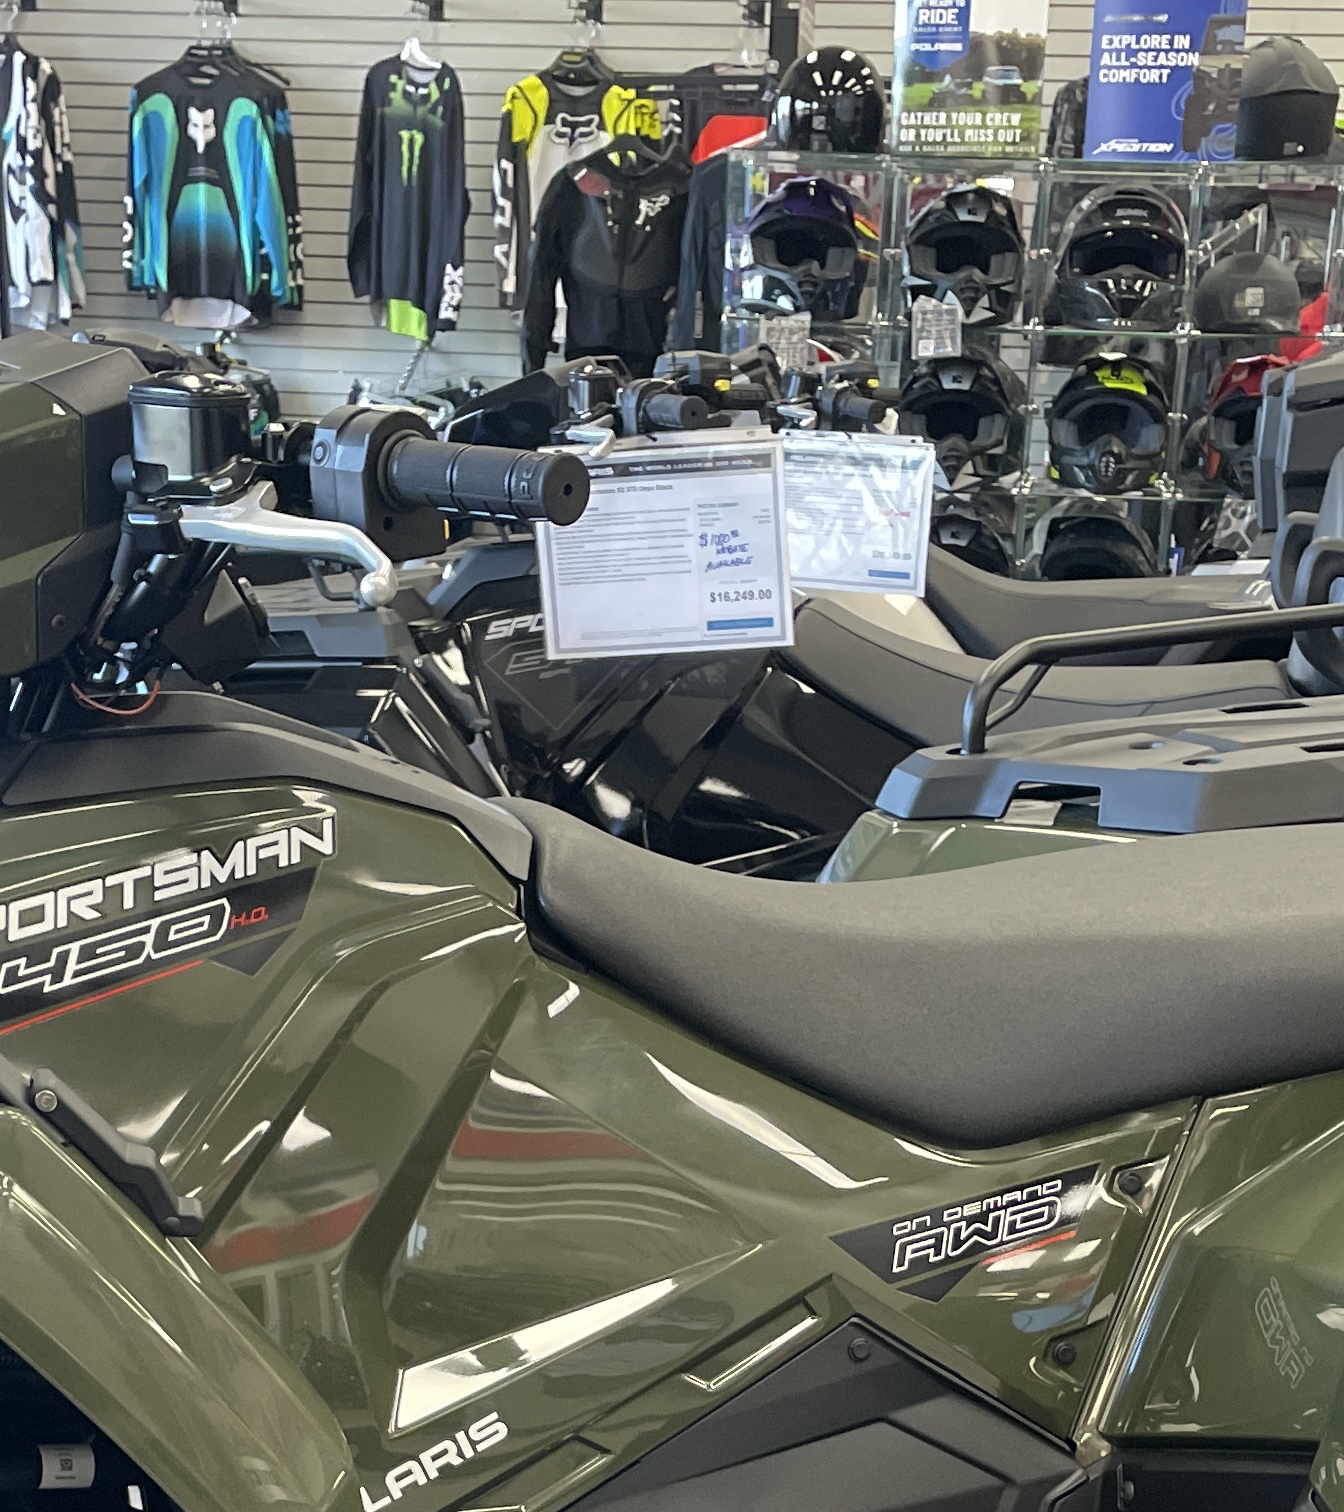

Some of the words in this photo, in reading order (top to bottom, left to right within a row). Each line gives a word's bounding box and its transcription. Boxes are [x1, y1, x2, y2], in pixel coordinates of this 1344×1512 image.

[918, 8, 960, 25] RIDE
[1101, 34, 1171, 50] EXPLORE
[1173, 34, 1191, 50] IN
[1100, 51, 1200, 67] ALL-SEASON
[1098, 68, 1172, 84] COMFORT
[900, 112, 947, 127] GATHER
[951, 112, 983, 126] YOUR
[985, 112, 1022, 126] CREW
[899, 129, 916, 142] OR
[920, 129, 961, 143] YOU'LL
[964, 129, 994, 143] MISS
[997, 129, 1023, 143] OUT
[1092, 142, 1175, 155] XPEDITION
[709, 589, 773, 603] $16,249.00
[229, 905, 270, 930] H.O.
[892, 1215, 931, 1236] ON
[943, 1178, 1063, 1223] DEMAND
[891, 1196, 1062, 1274] AWD
